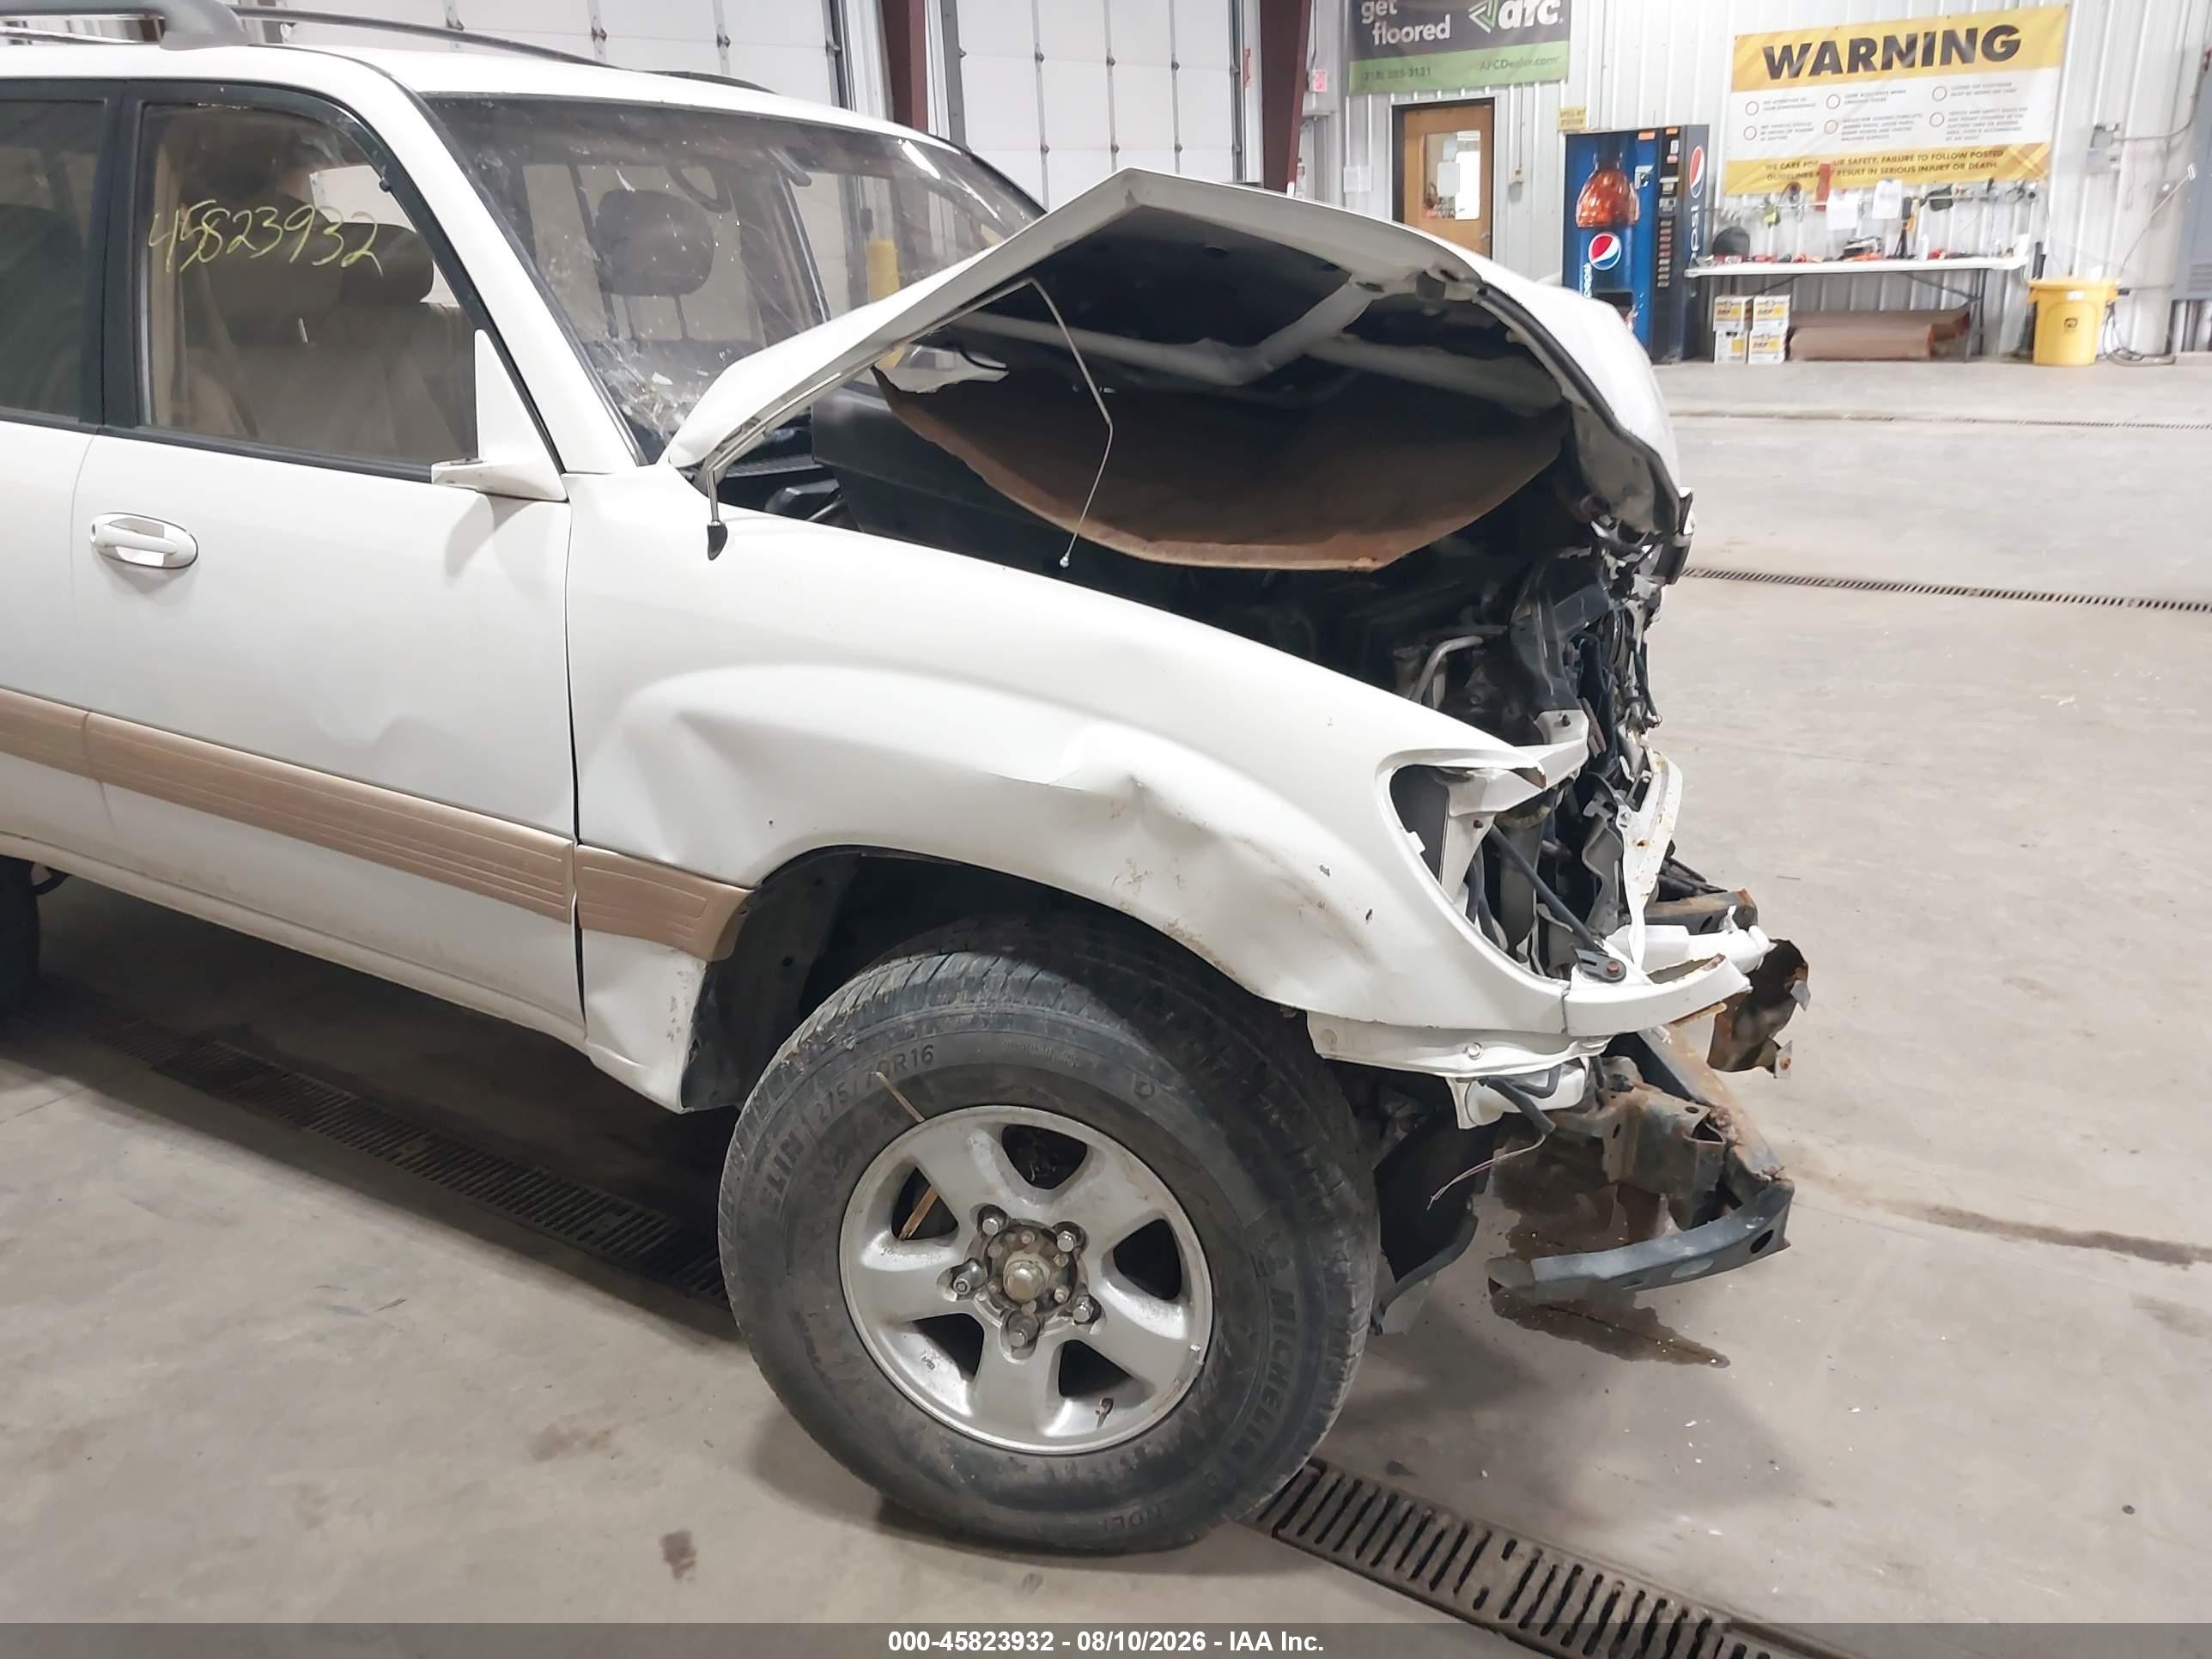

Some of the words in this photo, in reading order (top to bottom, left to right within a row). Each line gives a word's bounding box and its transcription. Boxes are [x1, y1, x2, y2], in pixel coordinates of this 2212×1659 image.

[1361, 0, 1398, 24] get
[1372, 14, 1451, 46] floored
[1762, 24, 2022, 81] WARNING
[1780, 161, 1801, 170] CARE
[1881, 155, 1915, 163] FAILURE
[1970, 150, 2004, 159] POSTED
[1881, 166, 1916, 174] SERIOUS
[1917, 164, 1950, 173] INJURY
[148, 200, 384, 276] 45823932
